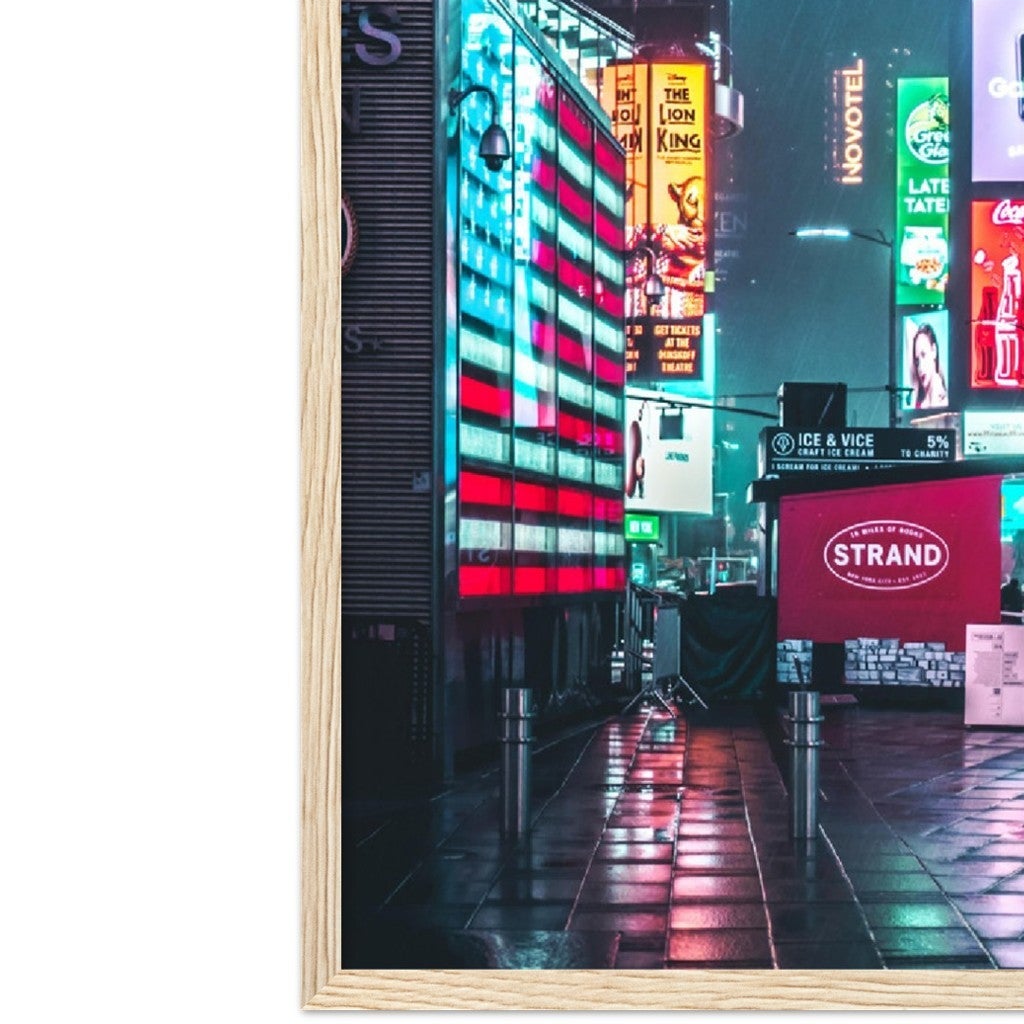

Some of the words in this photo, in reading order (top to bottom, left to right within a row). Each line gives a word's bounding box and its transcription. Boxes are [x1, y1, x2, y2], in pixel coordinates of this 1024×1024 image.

[664, 88, 690, 100] THE
[842, 59, 863, 183] NOVOTEL
[653, 325, 669, 336] GET
[670, 325, 701, 336] TICKETS
[664, 337, 675, 348] AT
[676, 337, 690, 348] THE
[798, 432, 821, 447] ICE
[826, 432, 837, 447] &
[841, 433, 874, 447] VICE
[927, 435, 950, 449] 5%
[798, 448, 825, 457] CRAFT
[827, 449, 841, 457] ICE
[844, 449, 874, 457] CREAM
[900, 449, 912, 458] TO
[914, 450, 949, 458] CHARITY
[777, 463, 804, 471] SCREAM
[834, 543, 942, 566] STRAND
